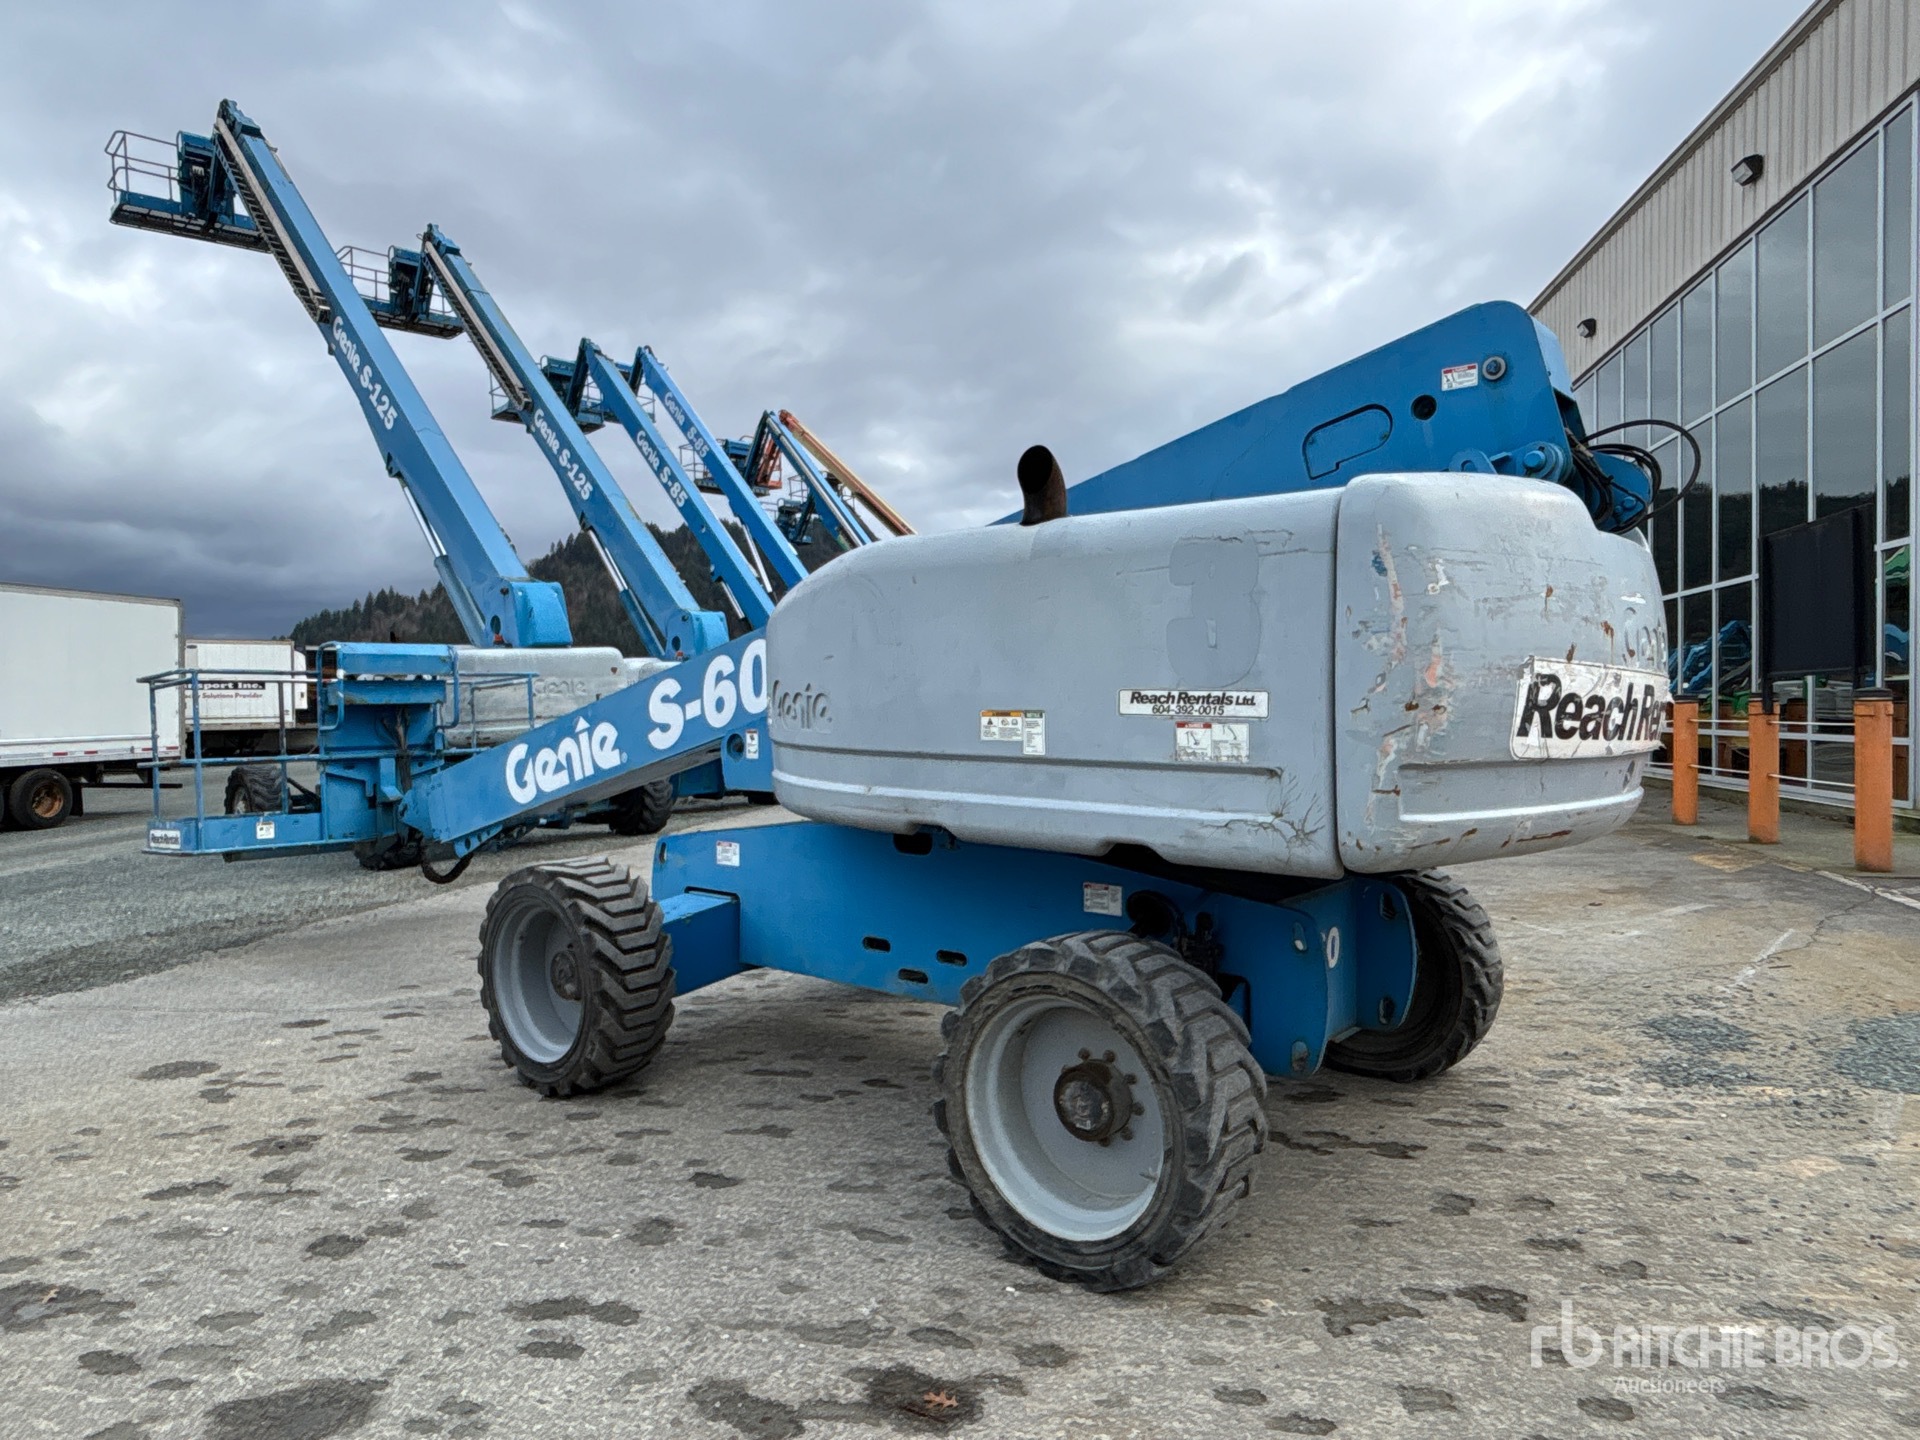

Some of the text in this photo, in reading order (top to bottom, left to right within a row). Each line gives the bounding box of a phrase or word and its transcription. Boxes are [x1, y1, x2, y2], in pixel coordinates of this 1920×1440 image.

[333, 316, 398, 430] Genie S-125
[534, 409, 593, 500] Genie S-125
[636, 430, 688, 508] Genie S-85
[506, 638, 767, 804] Genie S-60
[1130, 691, 1256, 706] Reach Rentals Ltd.
[1152, 704, 1225, 716] 604-392-0015
[1516, 673, 1638, 742] Reach
